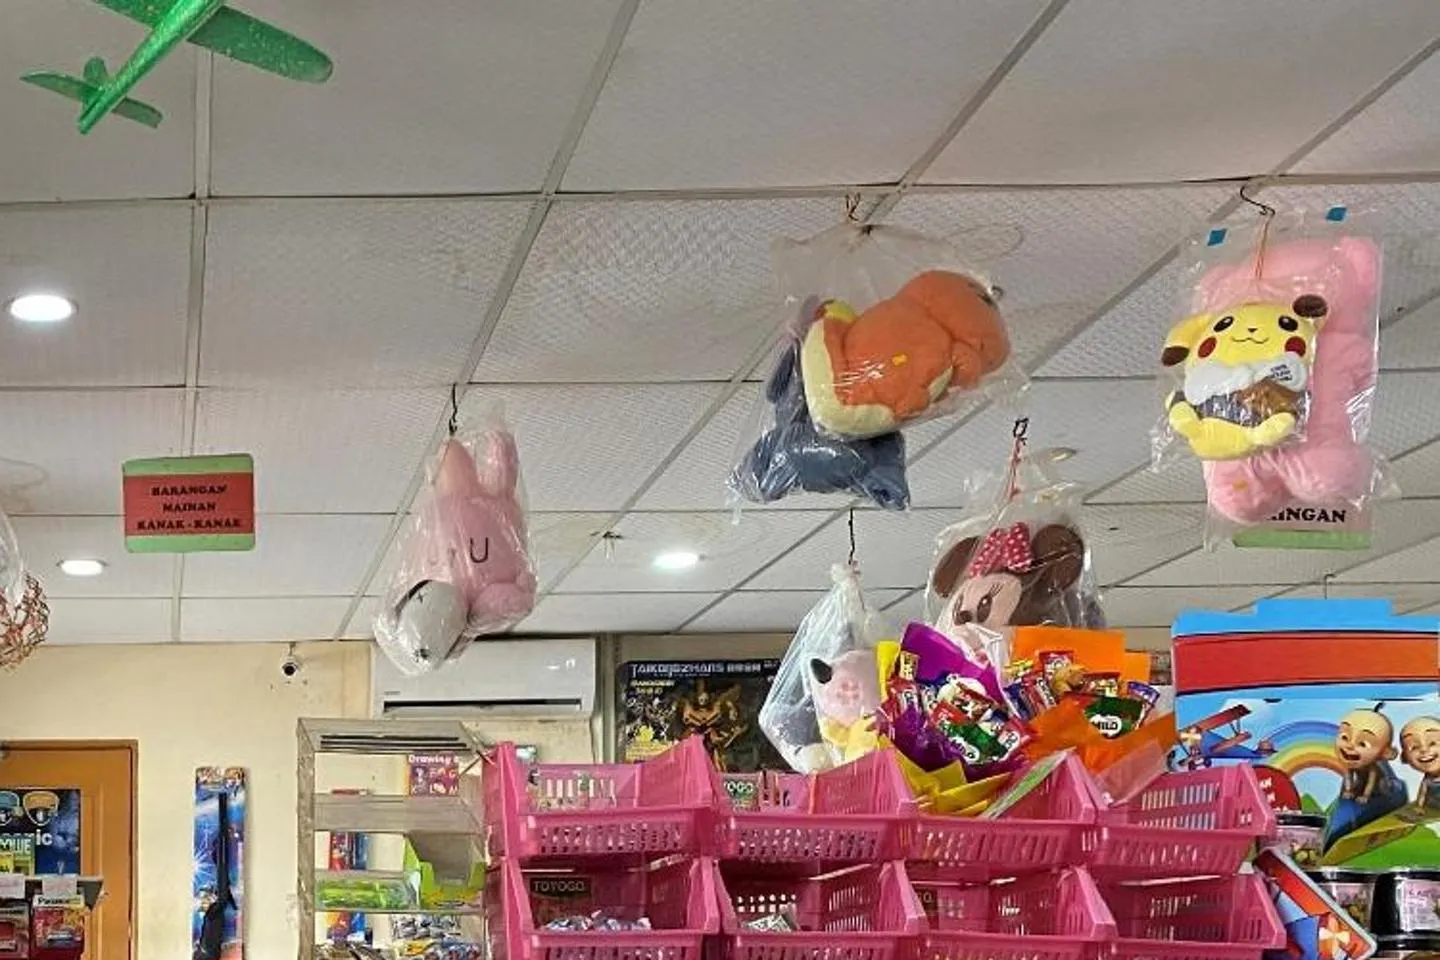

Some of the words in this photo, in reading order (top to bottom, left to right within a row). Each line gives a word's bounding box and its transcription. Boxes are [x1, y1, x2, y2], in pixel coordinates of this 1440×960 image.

[151, 485, 227, 496] BARANGAN
[163, 503, 216, 513] MAINAN
[1268, 507, 1346, 522] INGAN
[409, 754, 453, 767] Drawing
[534, 880, 586, 893] TOYOGO
